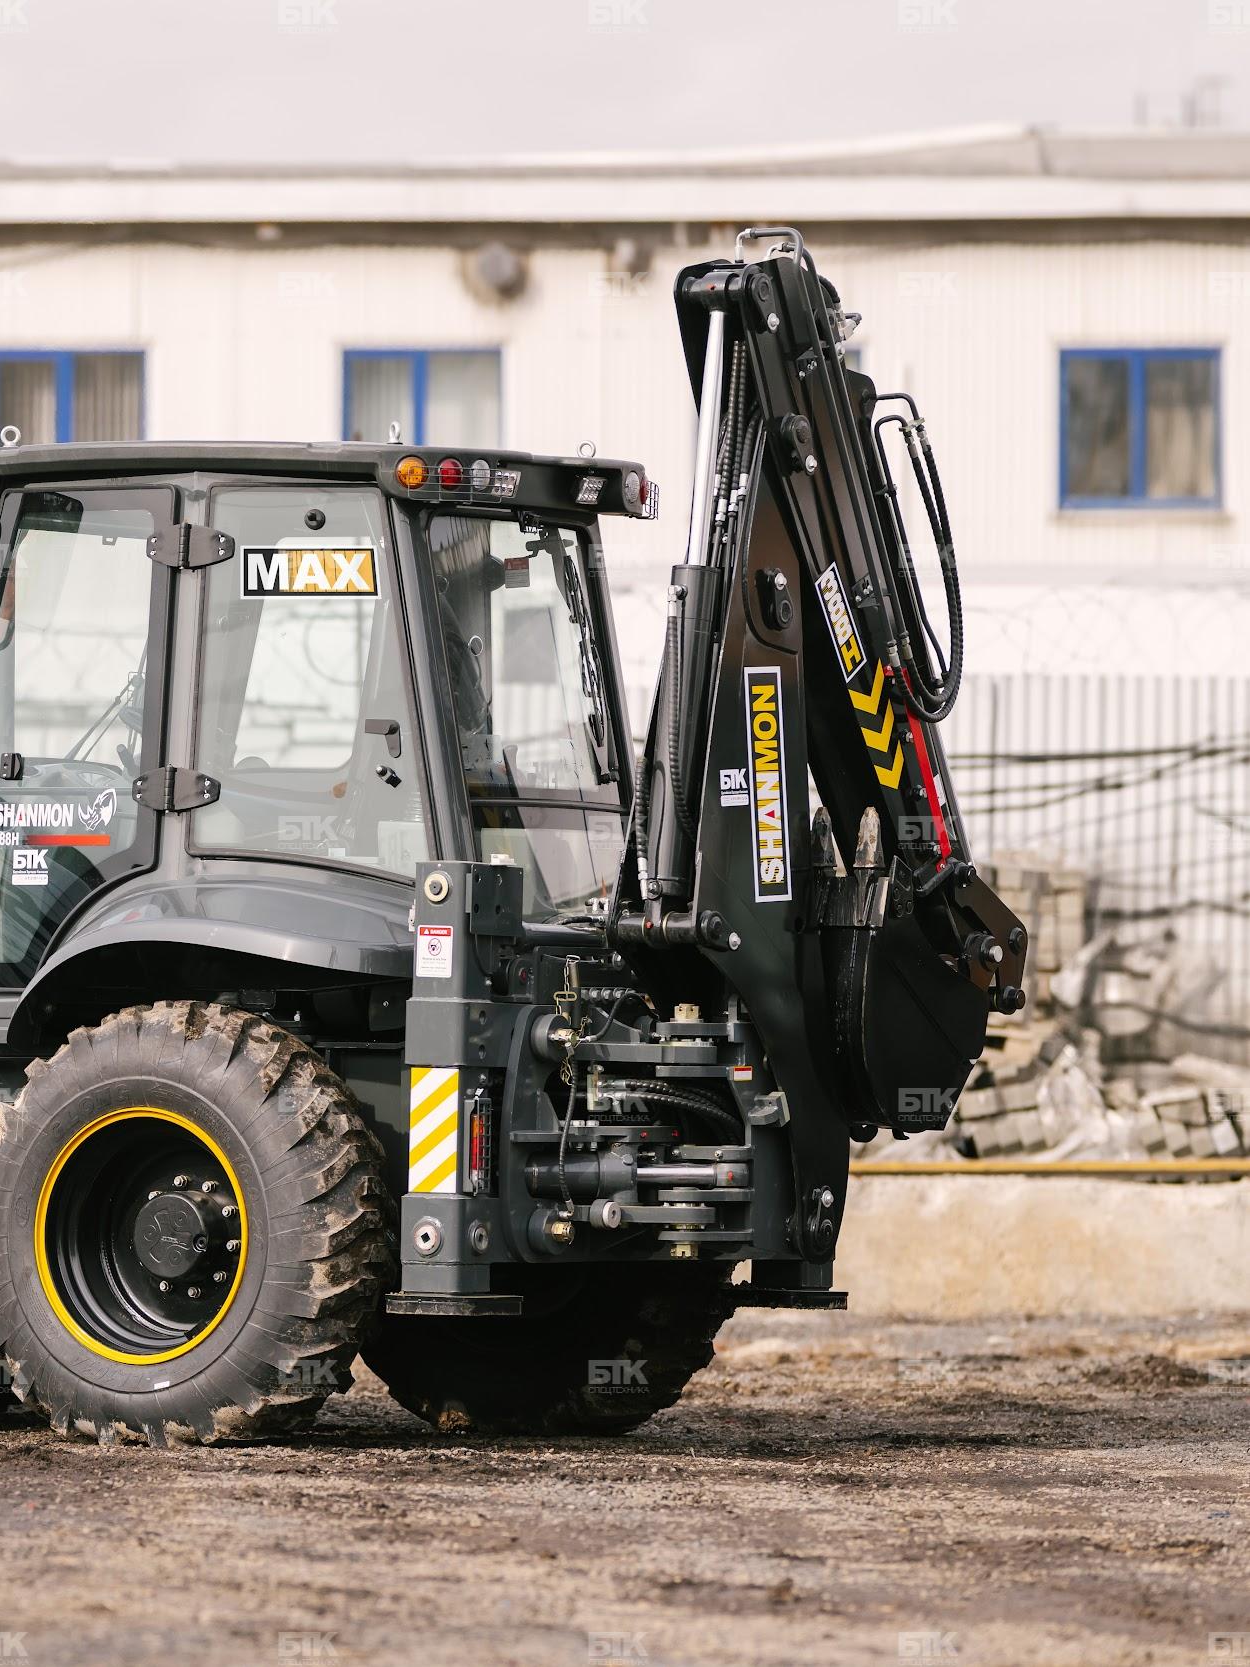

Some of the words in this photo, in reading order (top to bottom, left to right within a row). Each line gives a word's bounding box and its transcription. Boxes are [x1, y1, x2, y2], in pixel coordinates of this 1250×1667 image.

[247, 553, 370, 591] MAX
[820, 570, 862, 673] 388H
[719, 768, 748, 790] БТК
[751, 684, 785, 885] SHANMON
[12, 849, 49, 870] БТК
